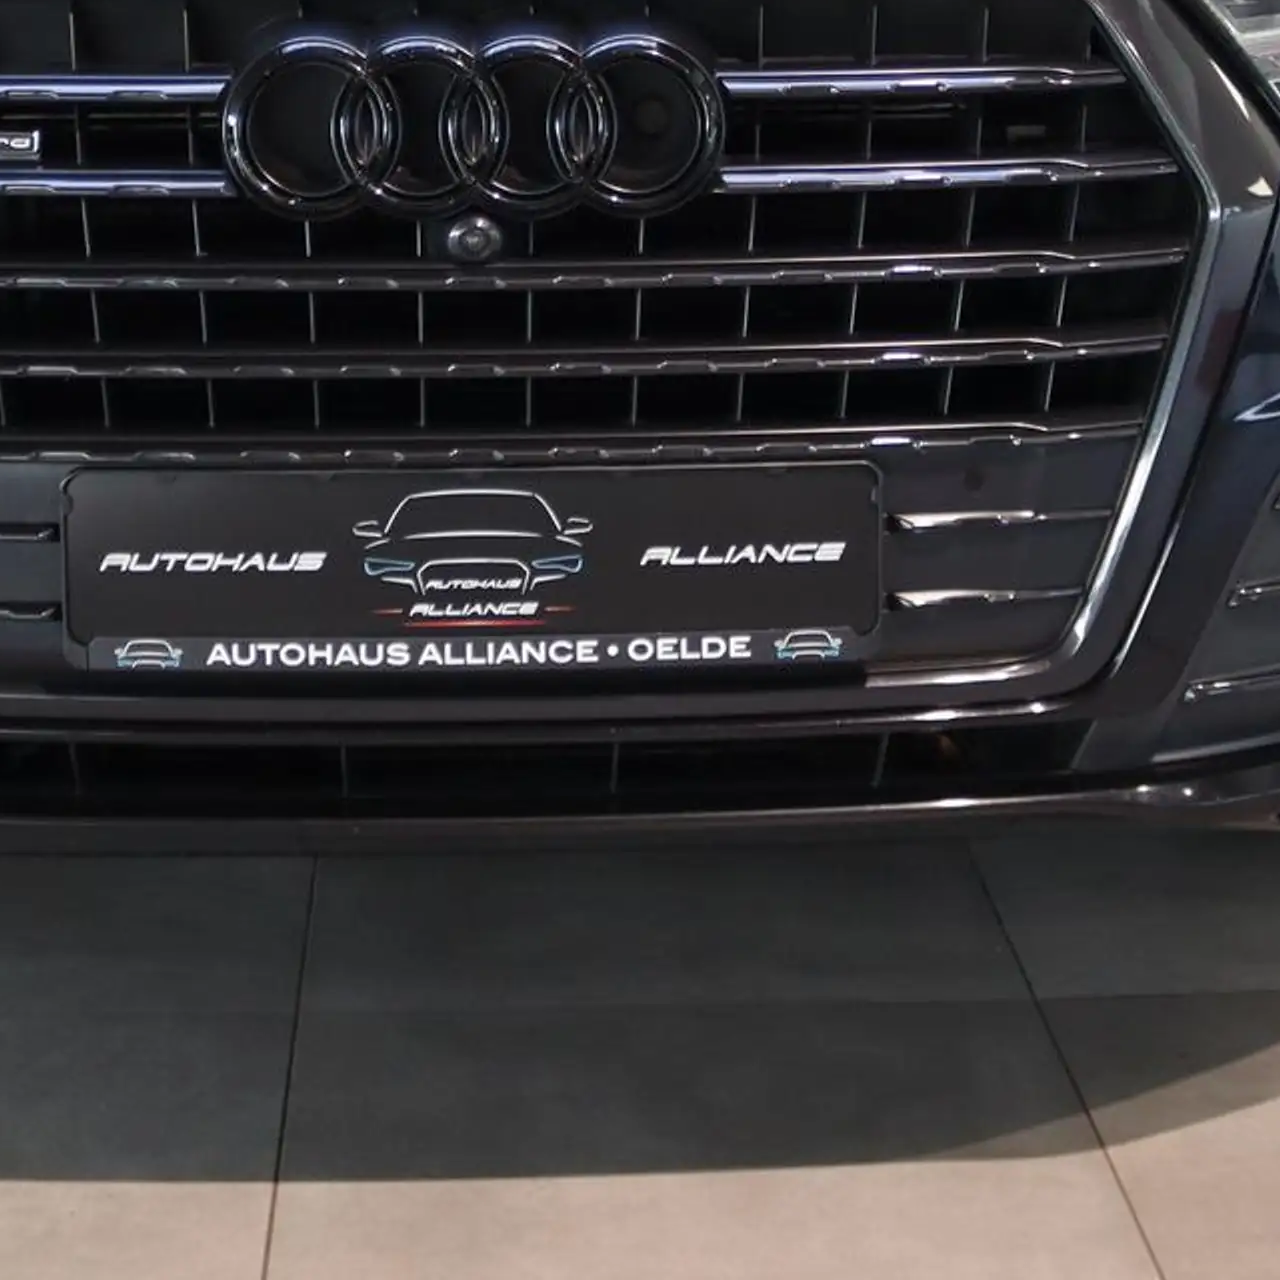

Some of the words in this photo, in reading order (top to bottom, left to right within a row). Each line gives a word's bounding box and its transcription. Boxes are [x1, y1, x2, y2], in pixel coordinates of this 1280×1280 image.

[99, 551, 327, 573] AUTOHAUS
[639, 541, 847, 566] ALLIANCE
[424, 578, 523, 590] AUTOHAUS
[409, 601, 539, 617] ALLIANCE
[205, 641, 412, 667] AUTOHAUS
[417, 638, 600, 666] ALLIANCE
[627, 634, 753, 662] OELDE
